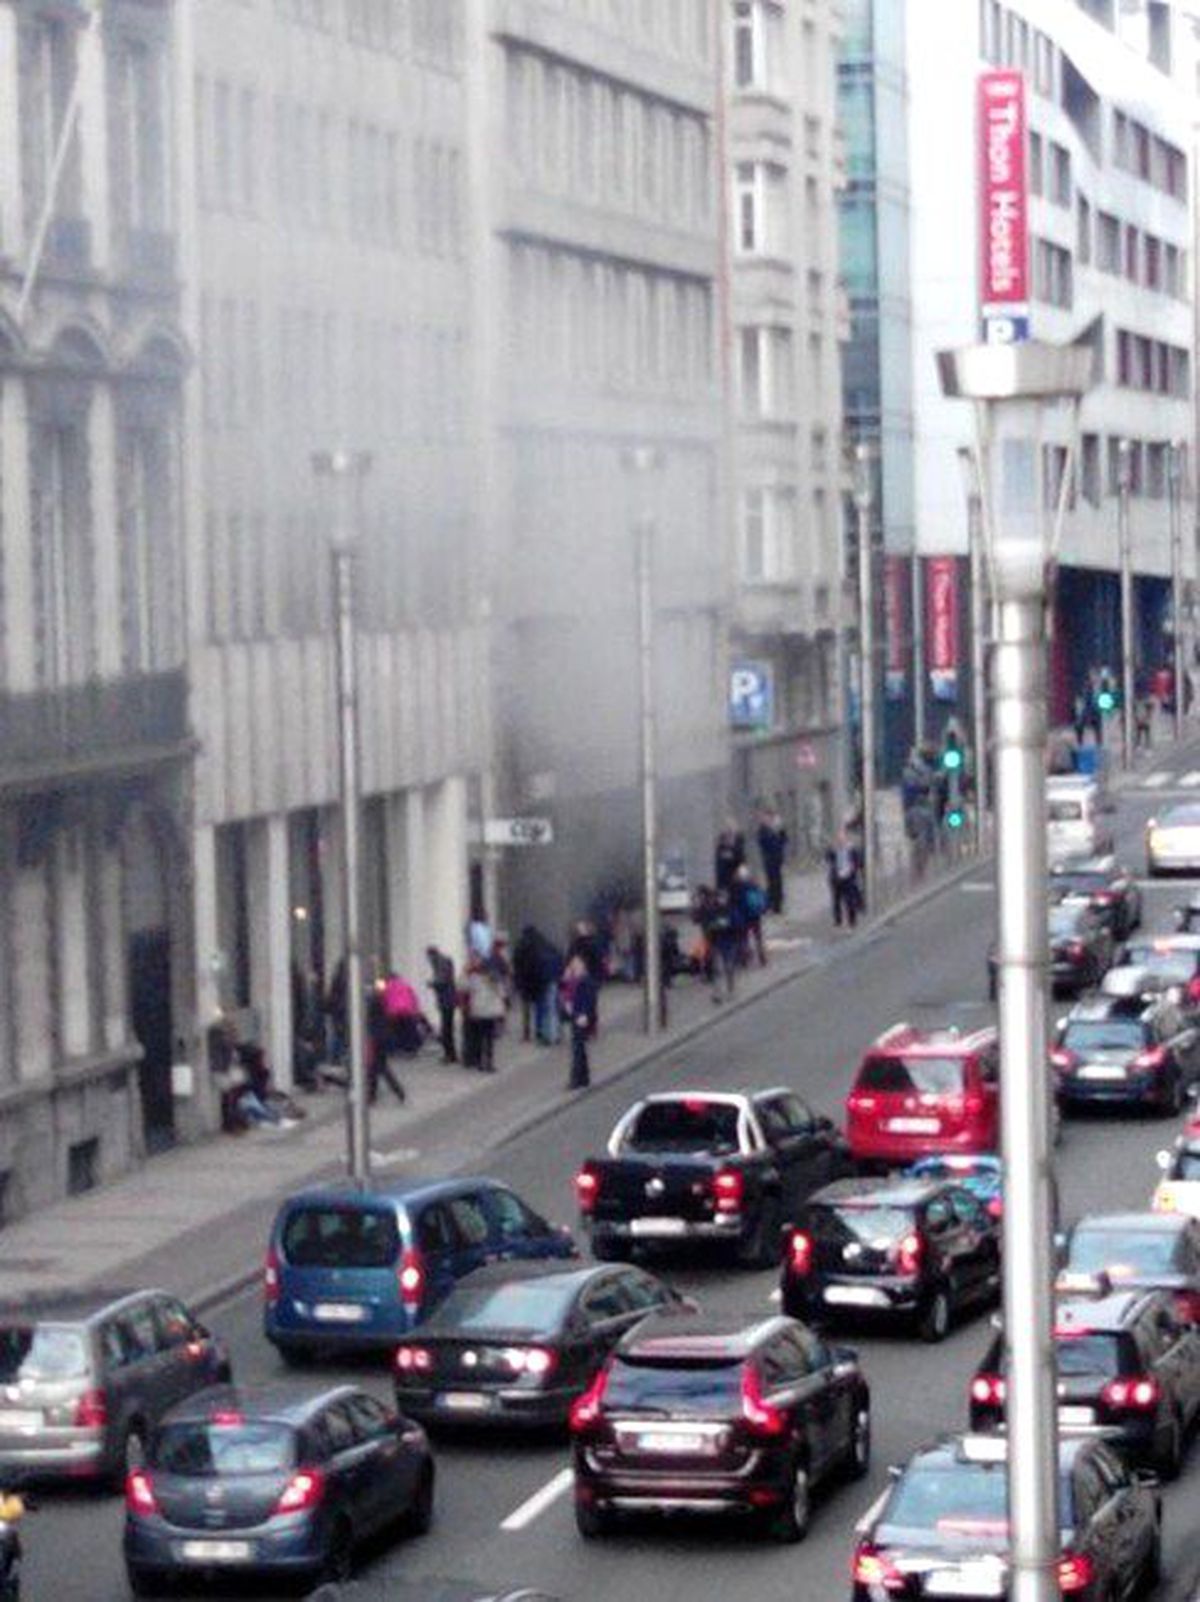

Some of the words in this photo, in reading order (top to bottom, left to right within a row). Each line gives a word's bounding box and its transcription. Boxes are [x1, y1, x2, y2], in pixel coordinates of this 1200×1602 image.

[988, 101, 1018, 183] Thon
[989, 190, 1020, 292] Hotels
[731, 670, 758, 704] P
